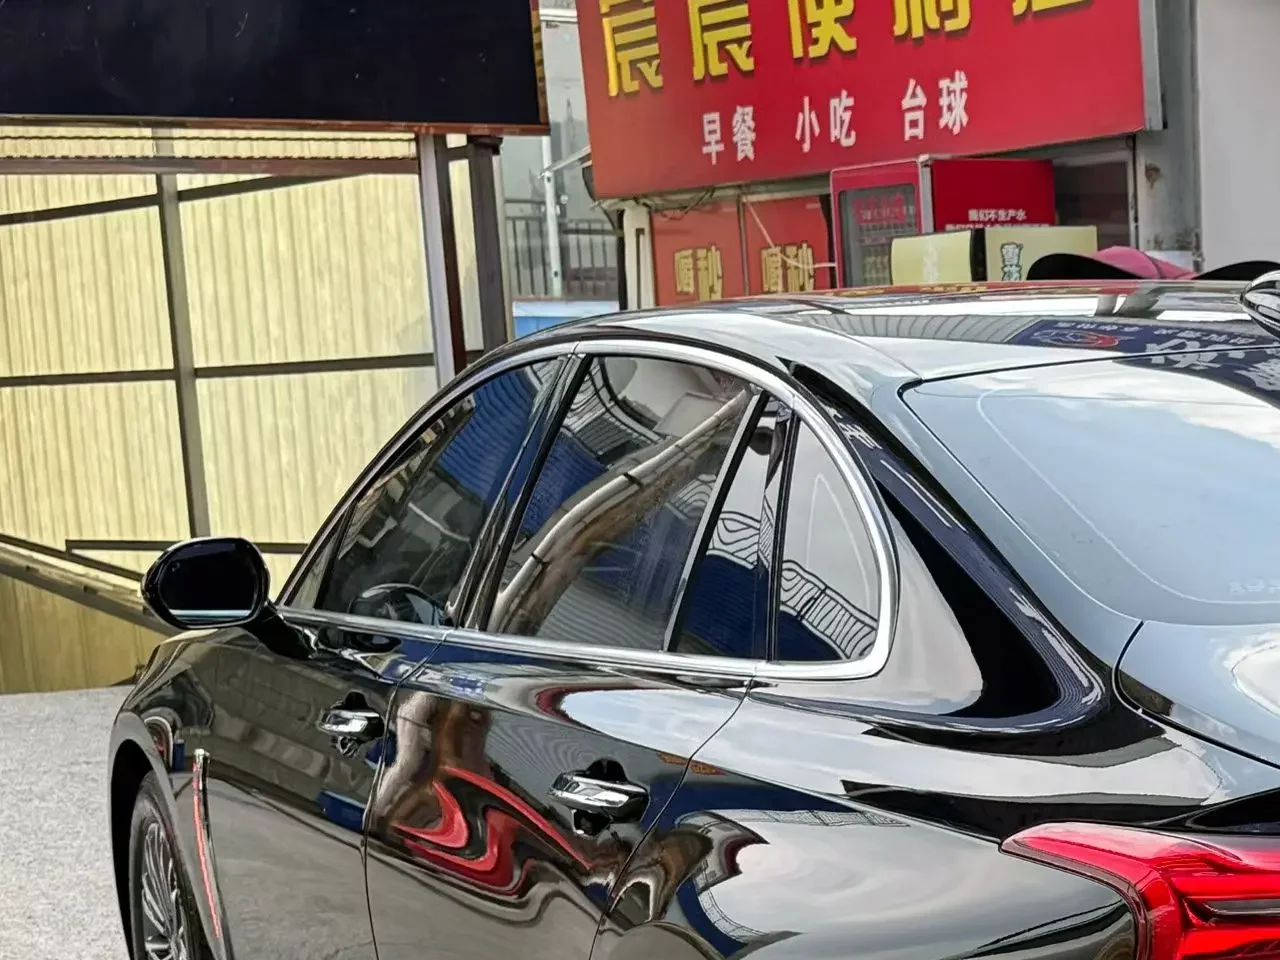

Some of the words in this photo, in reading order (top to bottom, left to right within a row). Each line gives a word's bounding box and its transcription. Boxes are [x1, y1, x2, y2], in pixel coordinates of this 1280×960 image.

[702, 105, 756, 165] 早餐
[795, 89, 856, 153] 小吃
[901, 69, 969, 141] 台球
